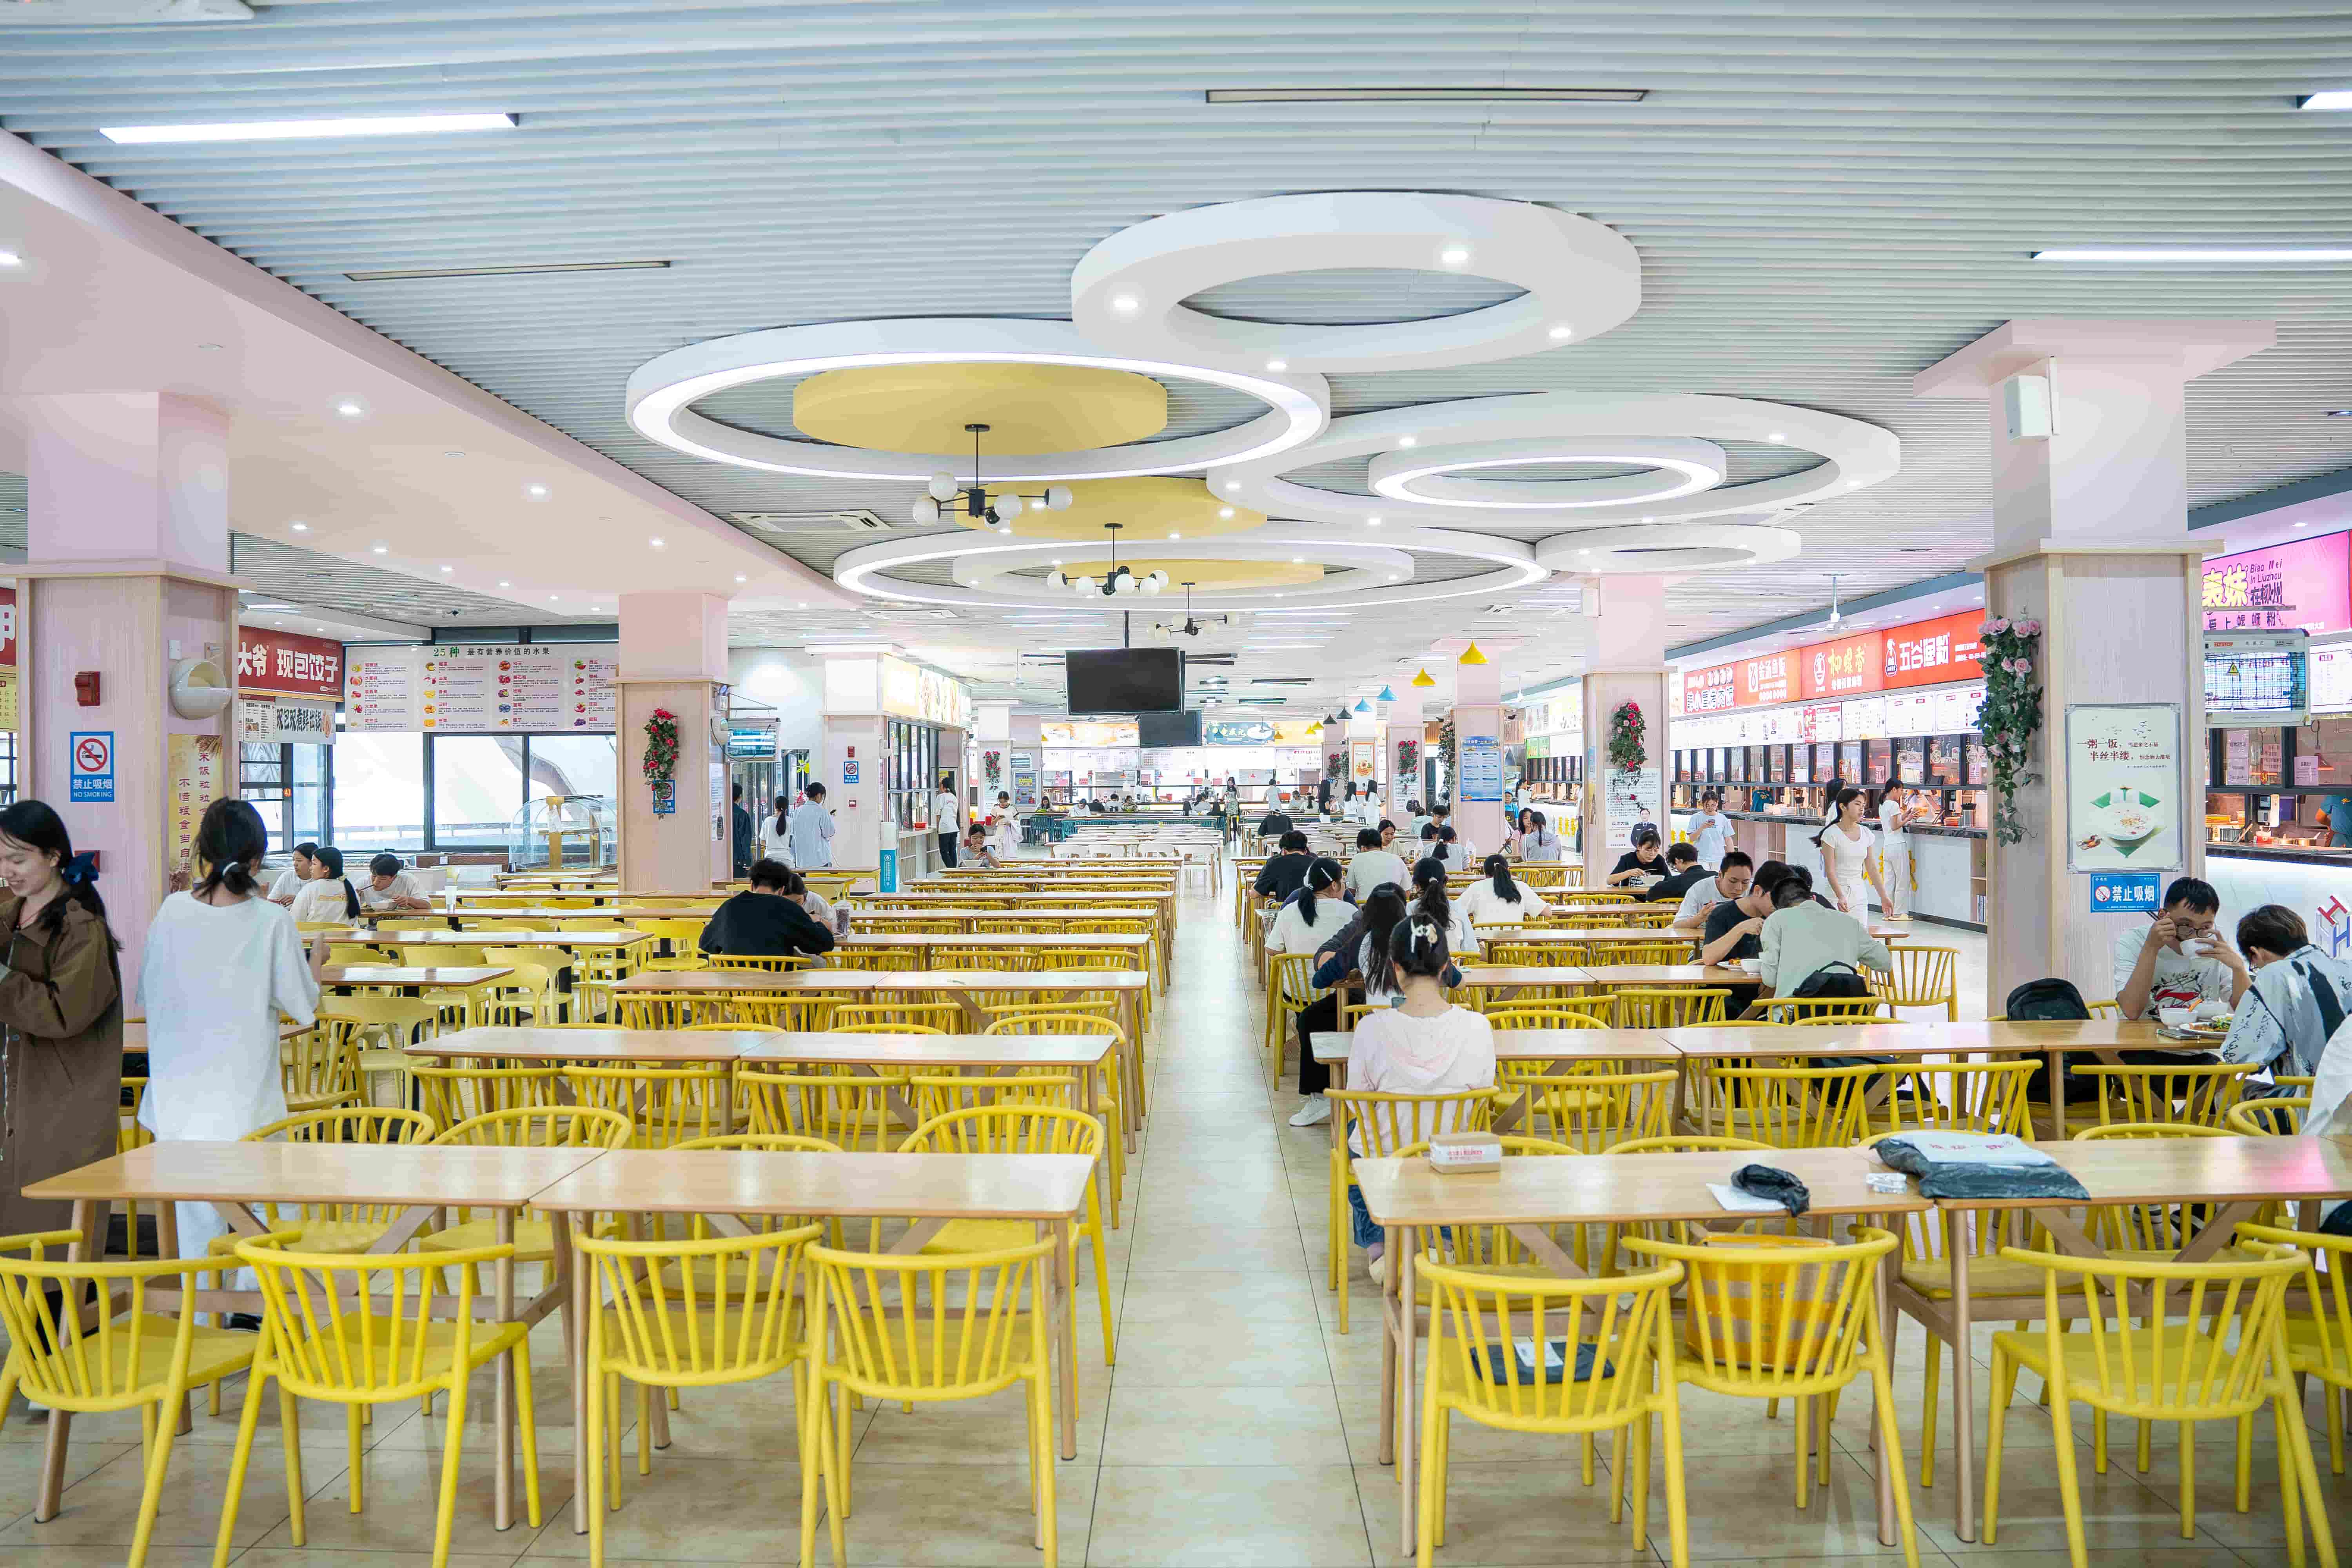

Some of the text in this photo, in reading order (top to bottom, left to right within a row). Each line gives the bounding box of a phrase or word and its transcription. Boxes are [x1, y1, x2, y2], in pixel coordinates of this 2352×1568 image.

[2250, 564, 2265, 573] Biao
[433, 646, 550, 658] 25 种 最有营养价值的水果
[276, 648, 338, 682] 现包饺子
[72, 778, 113, 789] 禁止吸烟
[2112, 885, 2155, 902] 禁止吸烟
